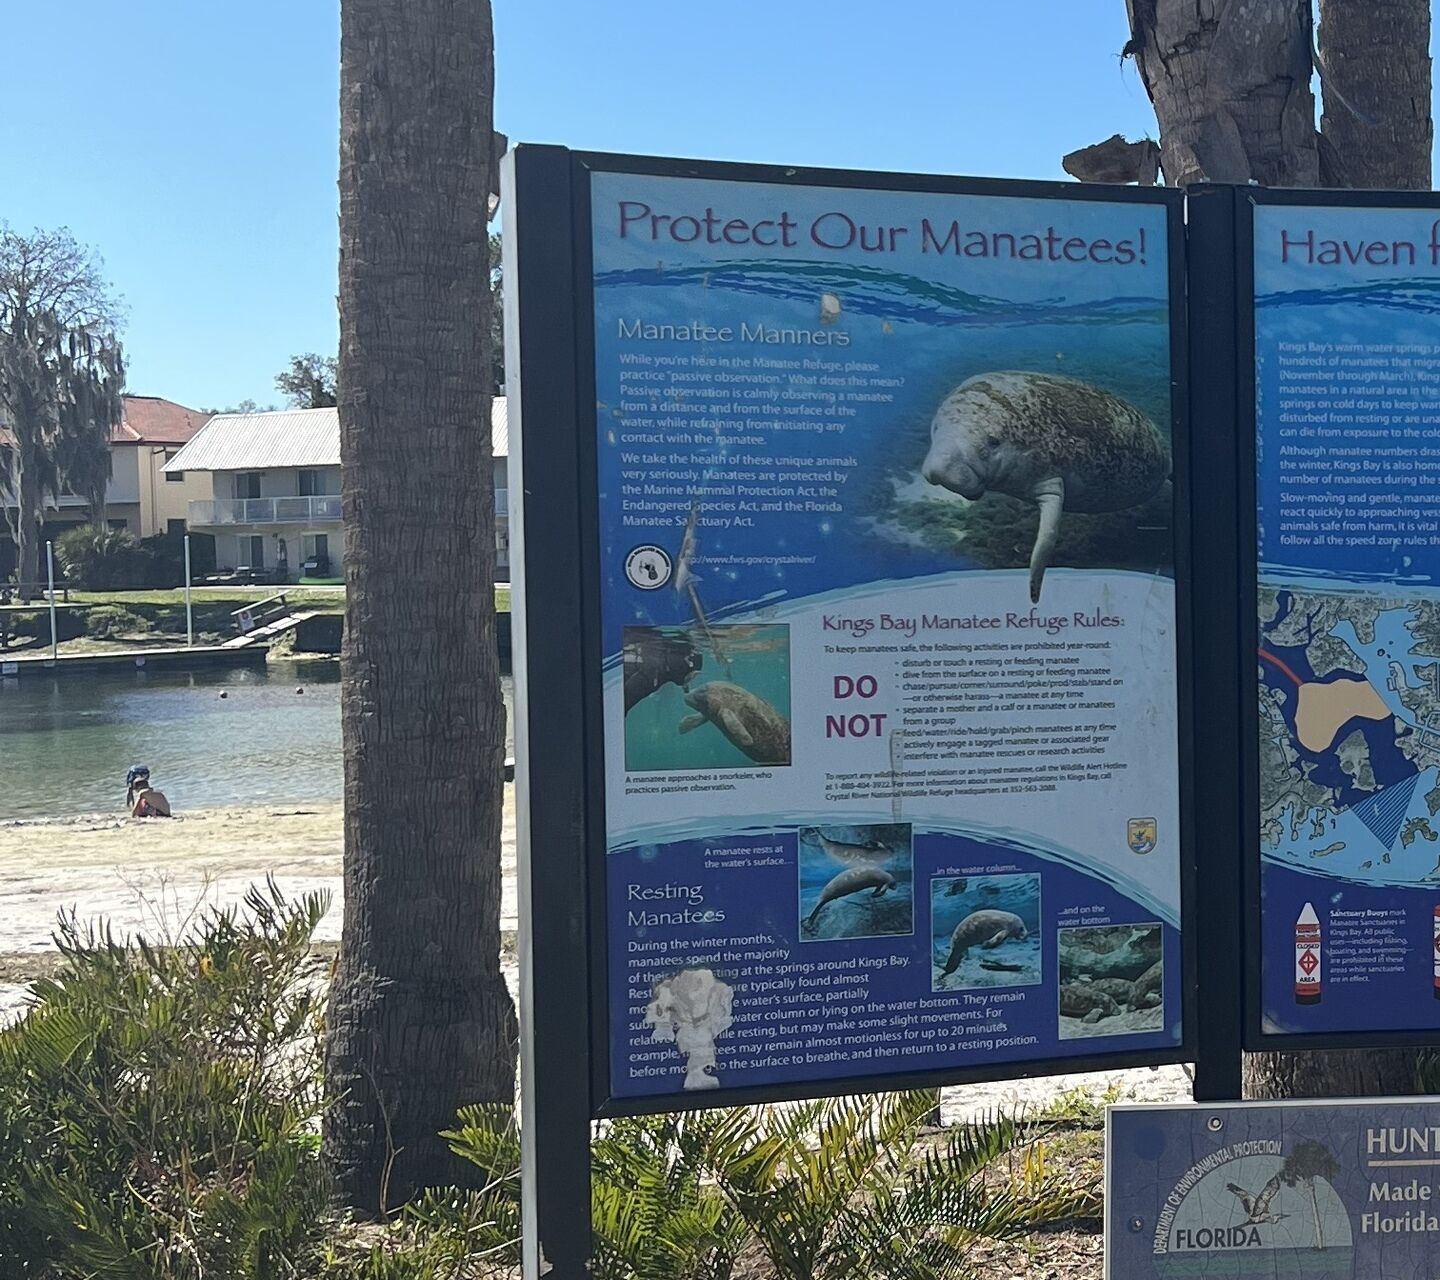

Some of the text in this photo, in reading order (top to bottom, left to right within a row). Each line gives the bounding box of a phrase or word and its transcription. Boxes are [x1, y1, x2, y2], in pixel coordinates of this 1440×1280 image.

[618, 201, 1147, 266] Protect Our Manatees!
[1281, 229, 1415, 265] Haven
[618, 318, 850, 346] Manatee Manners
[622, 452, 857, 467] We take the health of these unique animals
[1280, 446, 1326, 457] Although
[1328, 446, 1372, 455] manatee
[1374, 446, 1417, 456] numbers
[622, 472, 646, 481] very
[649, 470, 699, 482] seriously.
[702, 471, 756, 480] Manatees
[778, 471, 831, 483] protected
[834, 472, 848, 483] by
[1280, 460, 1296, 469] the
[1298, 460, 1332, 472] winter,
[1334, 461, 1360, 472] Kings
[1363, 461, 1380, 472] Bay
[1383, 461, 1390, 470] is
[1392, 461, 1412, 470] also
[1280, 474, 1319, 484] number
[1321, 475, 1331, 484] of
[1334, 475, 1382, 484] manatees
[1384, 475, 1416, 487] during
[1419, 475, 1435, 484] the
[823, 607, 1125, 638] Kings Bay Manatee Refuge Rules:
[833, 675, 878, 699] DO
[826, 714, 887, 738] NOT
[705, 845, 784, 856] A manatee rests at
[705, 859, 719, 868] the
[721, 858, 751, 868] water's
[628, 881, 704, 905] Resting
[628, 907, 726, 926] Manatees
[628, 932, 775, 954] During the winter months,
[628, 948, 790, 967] manatees spend the majority
[1152, 1140, 1282, 1254] DEPARTMENT OF ENVIRONMENTAL PROTECTION
[1368, 1178, 1430, 1202] Made
[1360, 1207, 1437, 1234] Florida
[1176, 1227, 1262, 1249] FLORIDA
